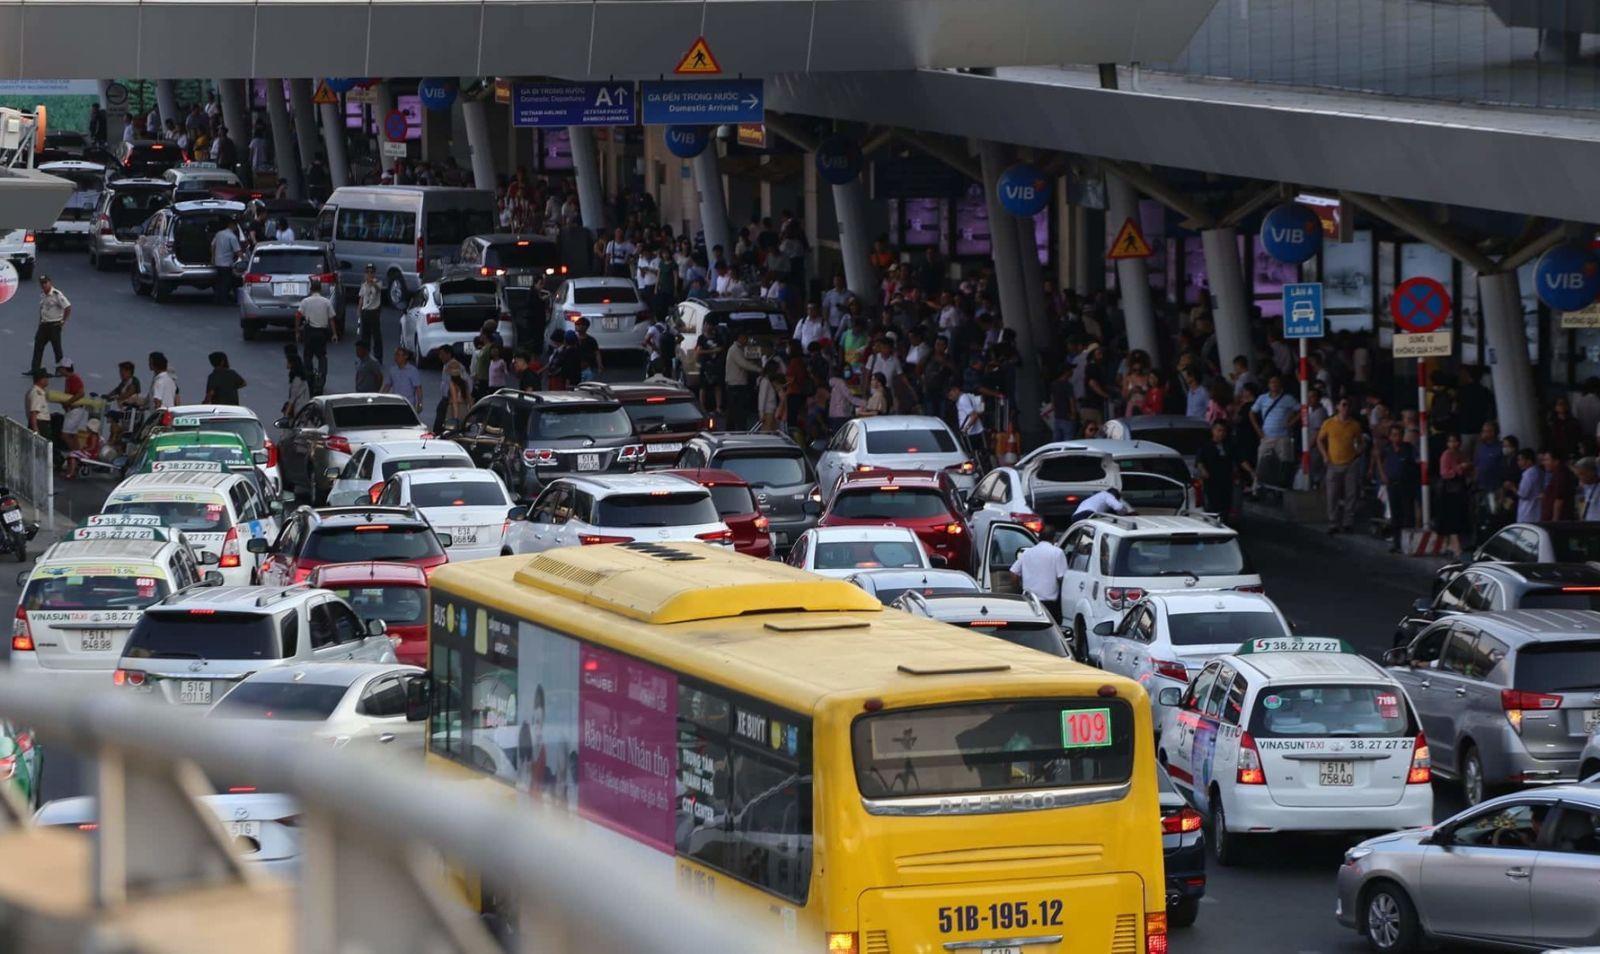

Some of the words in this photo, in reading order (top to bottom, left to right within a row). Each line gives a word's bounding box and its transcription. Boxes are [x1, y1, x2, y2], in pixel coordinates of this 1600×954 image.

[424, 87, 446, 98] VIB
[595, 87, 613, 106] A
[682, 92, 712, 101] TRONG
[669, 104, 706, 113] Domestic
[707, 104, 739, 112] Arrivals
[671, 130, 695, 145] VIB
[821, 153, 849, 169] VIB
[1005, 184, 1035, 200] VIB
[1271, 227, 1305, 244] VIB
[1545, 272, 1584, 290] VIB
[433, 603, 446, 627] BUS
[1308, 641, 1321, 650] 27
[1324, 641, 1338, 650] 27
[736, 709, 747, 735] XE
[1068, 711, 1107, 744] 109
[584, 718, 601, 751] Bảo
[603, 722, 626, 761] hiểm
[627, 735, 652, 772] Nhân
[1385, 740, 1398, 750] 27
[1401, 740, 1414, 750] 27
[1327, 763, 1345, 773] 51A
[682, 797, 695, 815] CITY
[694, 800, 715, 823] CENTER
[940, 793, 1056, 812] DAEWOO
[938, 899, 1063, 933] 51B-195.12
